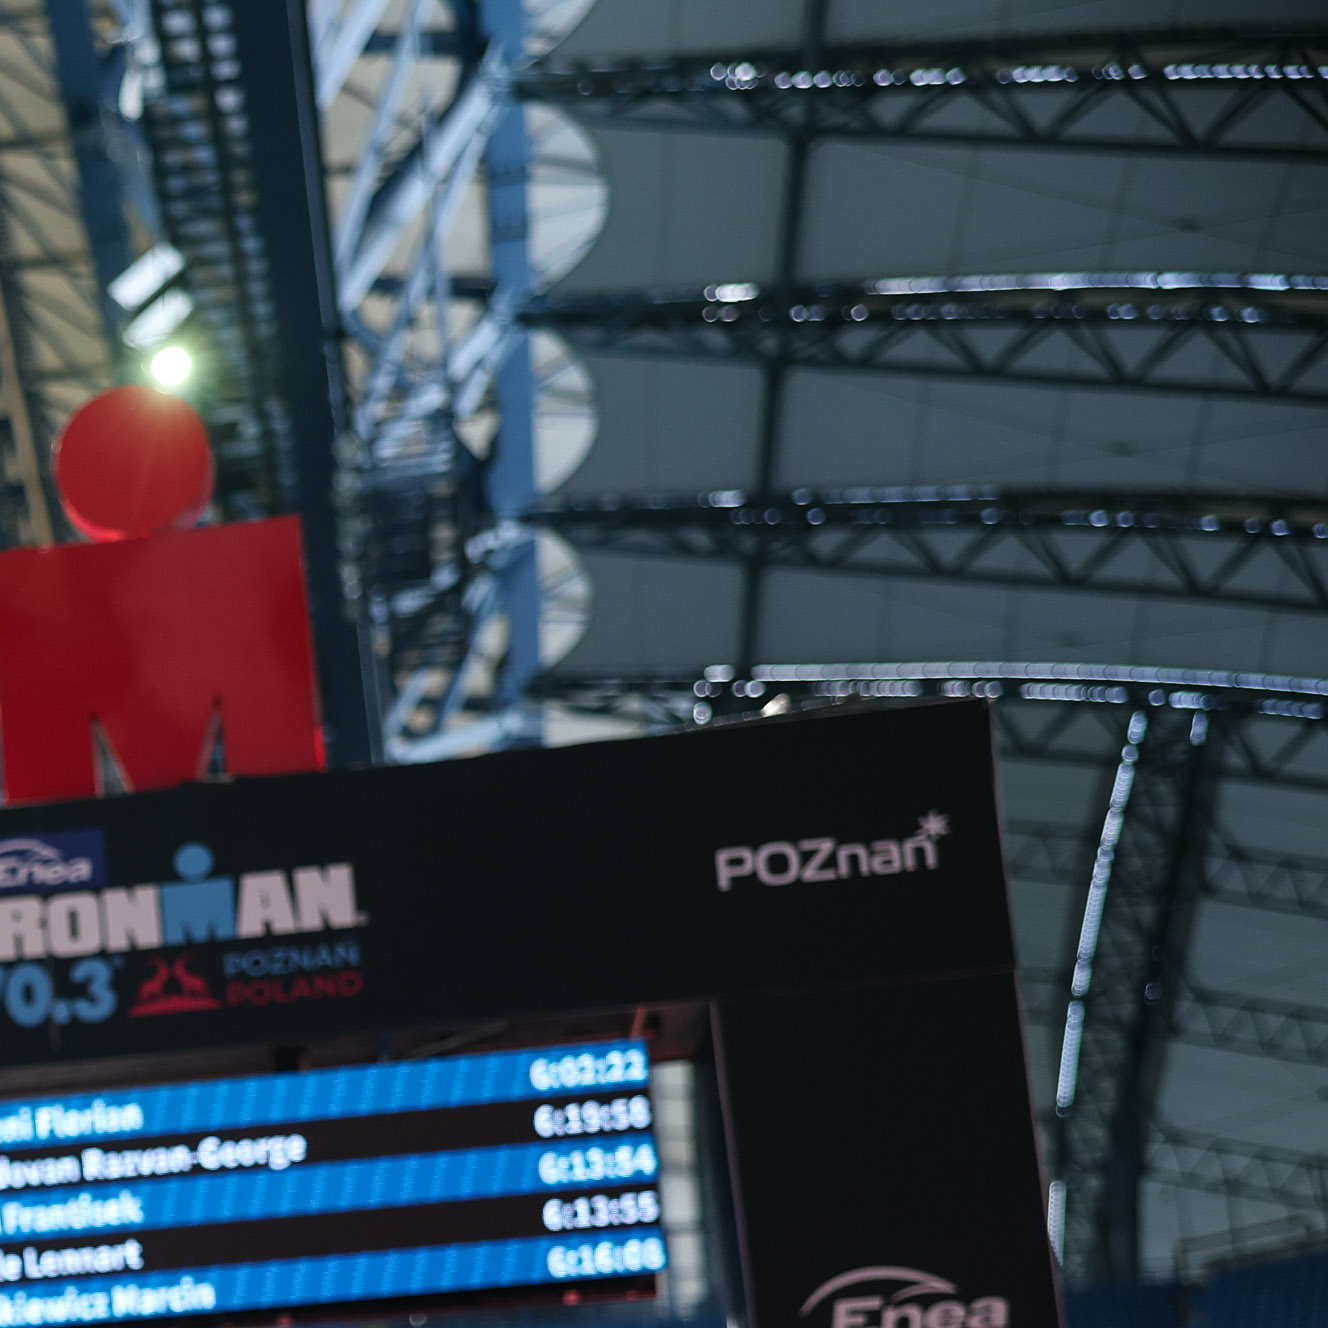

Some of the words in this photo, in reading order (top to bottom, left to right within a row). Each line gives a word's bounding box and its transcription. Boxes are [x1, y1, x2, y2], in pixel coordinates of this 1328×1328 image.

[225, 969, 365, 1008] POLAND
[35, 1099, 143, 1139] Florian
[81, 1134, 307, 1182] Razvan-George
[23, 1238, 143, 1280] Lennart
